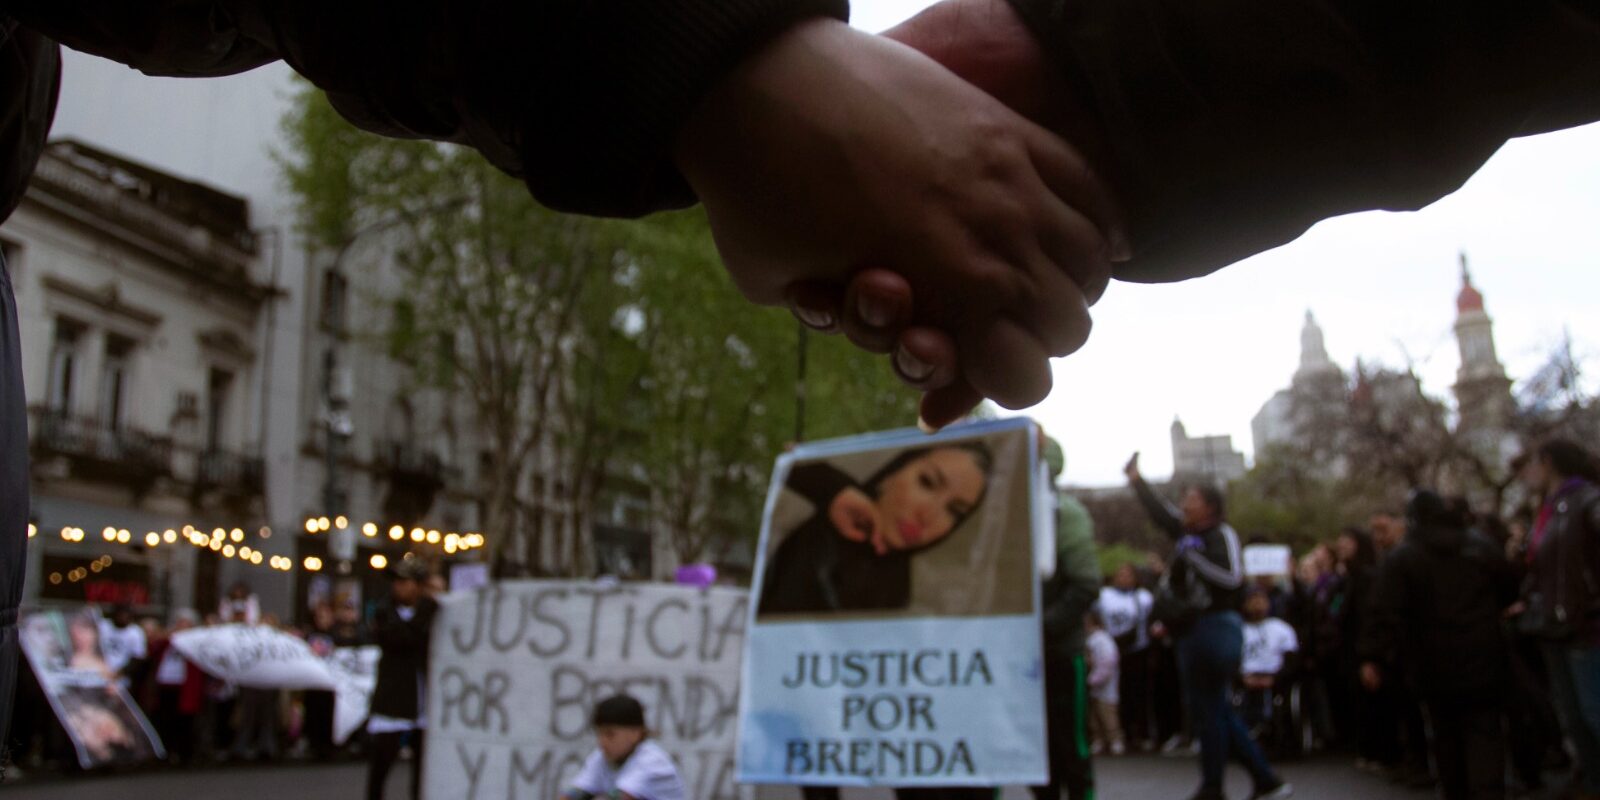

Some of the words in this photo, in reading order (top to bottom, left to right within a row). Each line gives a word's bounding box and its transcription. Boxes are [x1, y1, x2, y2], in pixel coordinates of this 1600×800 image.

[782, 650, 993, 688] JUSTICIA
[842, 694, 937, 732] POR
[456, 743, 487, 800] Y
[785, 738, 976, 777] BRENDA
